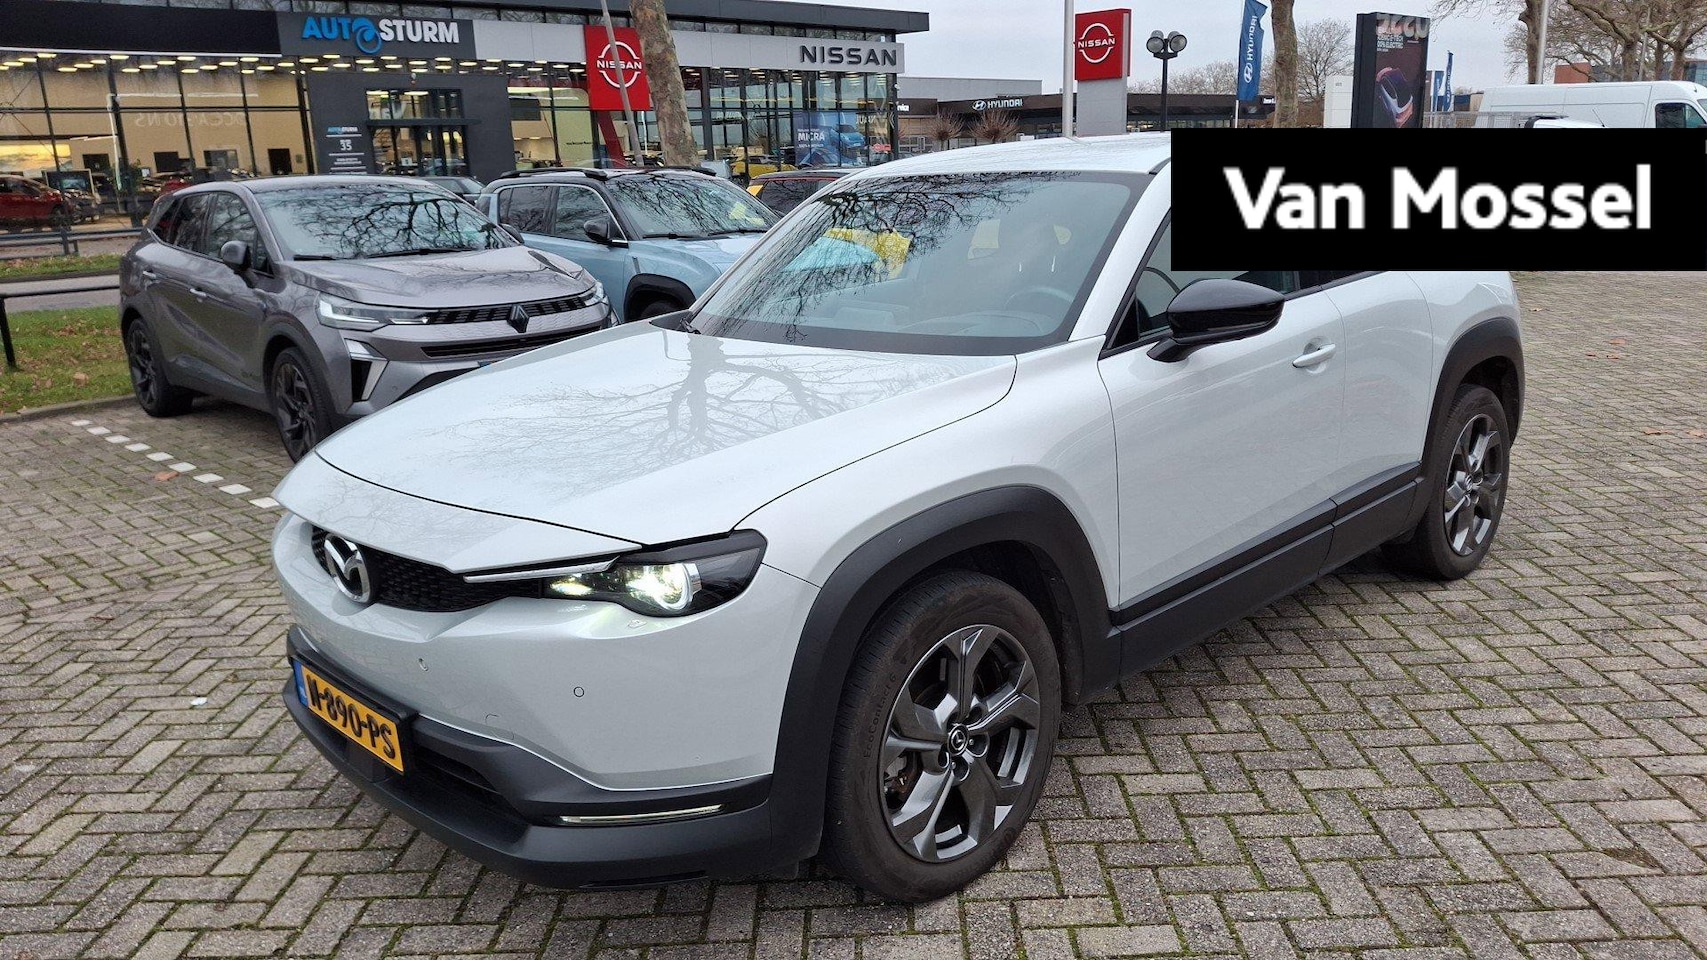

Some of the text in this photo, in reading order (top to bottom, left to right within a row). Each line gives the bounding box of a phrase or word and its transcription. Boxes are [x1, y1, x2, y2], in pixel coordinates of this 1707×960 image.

[1078, 38, 1115, 48] NISSAN
[1247, 15, 1258, 61] HYUNDAI
[800, 45, 897, 67] NISSAN
[597, 60, 642, 69] NISSAN
[987, 98, 1023, 109] HYUNDAI
[797, 132, 825, 141] MICRA
[340, 142, 352, 151] 35
[306, 674, 396, 760] N-890-PS
